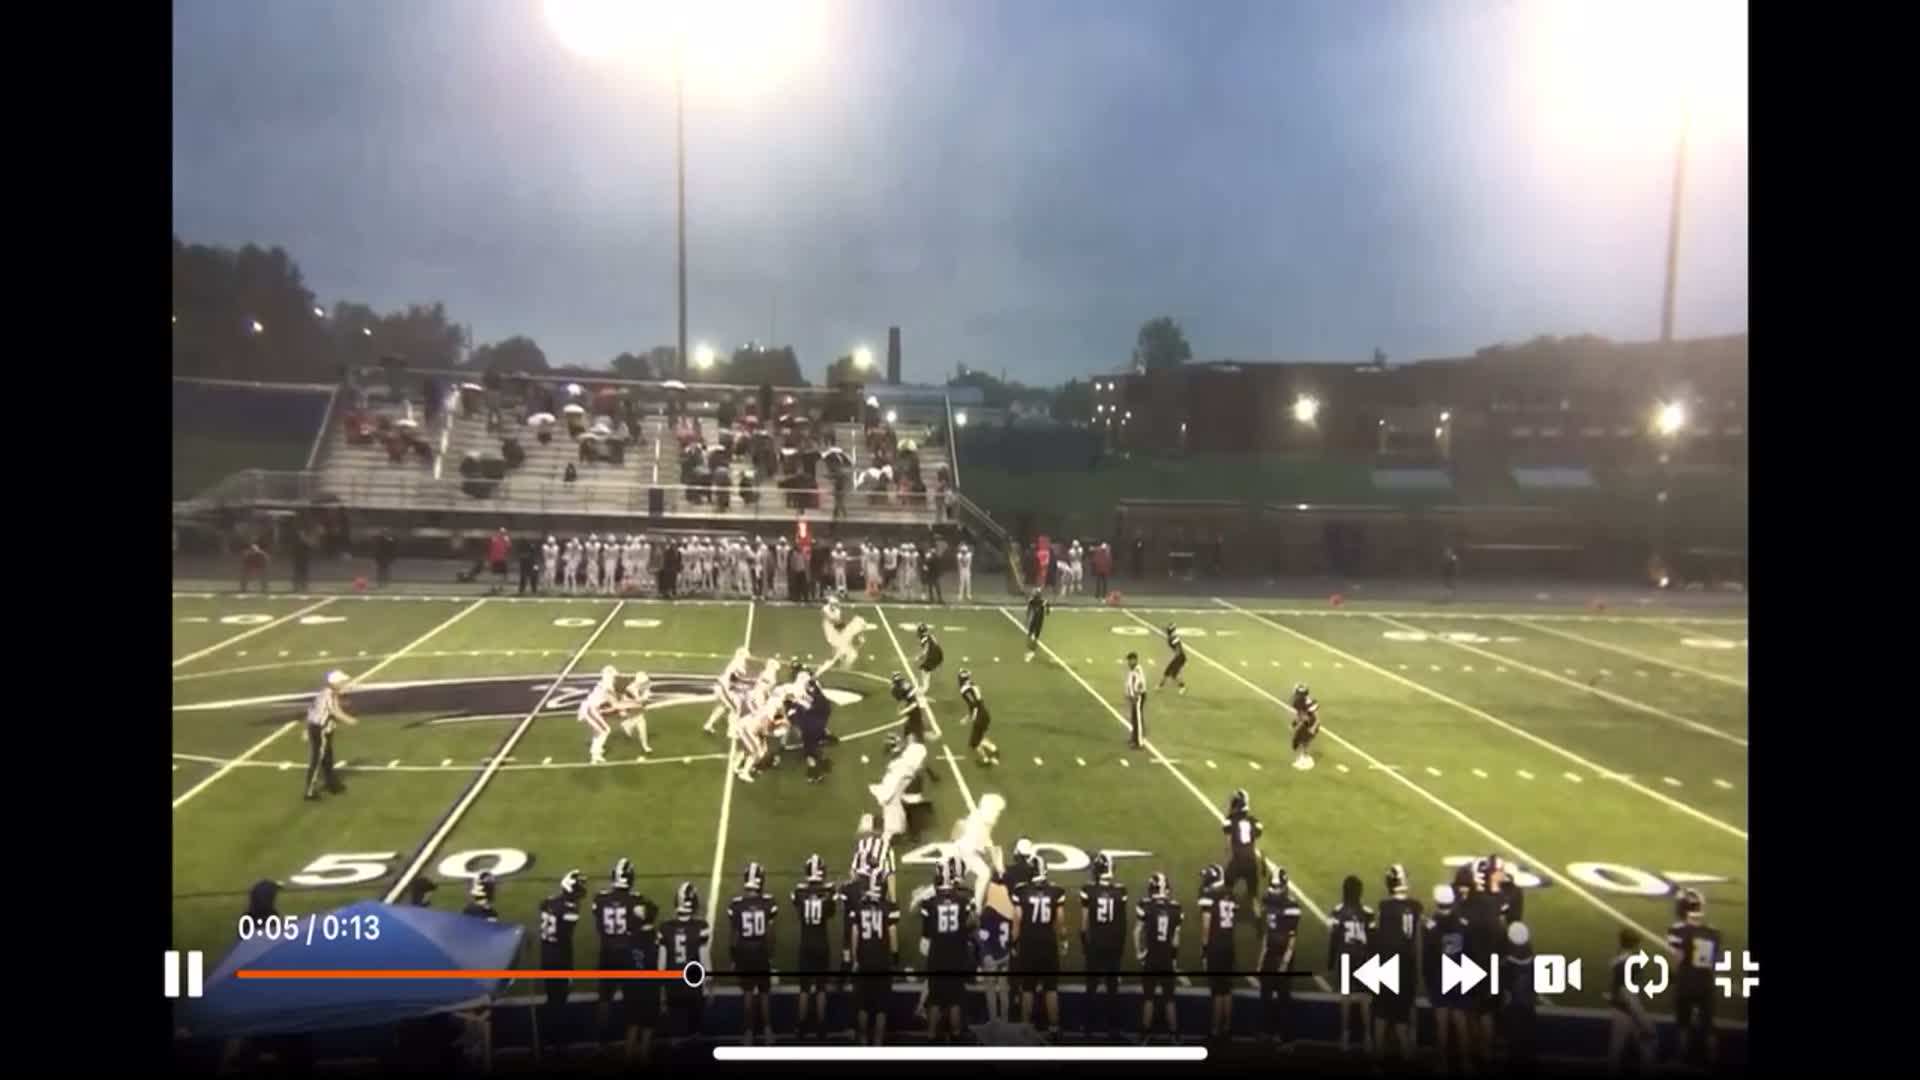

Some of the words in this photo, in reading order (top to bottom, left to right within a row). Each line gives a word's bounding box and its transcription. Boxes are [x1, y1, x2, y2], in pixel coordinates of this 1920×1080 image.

[291, 848, 530, 885] 50
[603, 906, 628, 935] 55
[742, 910, 766, 937] 50
[1029, 896, 1051, 924] 76
[861, 910, 884, 940] 54
[675, 934, 688, 964] 5
